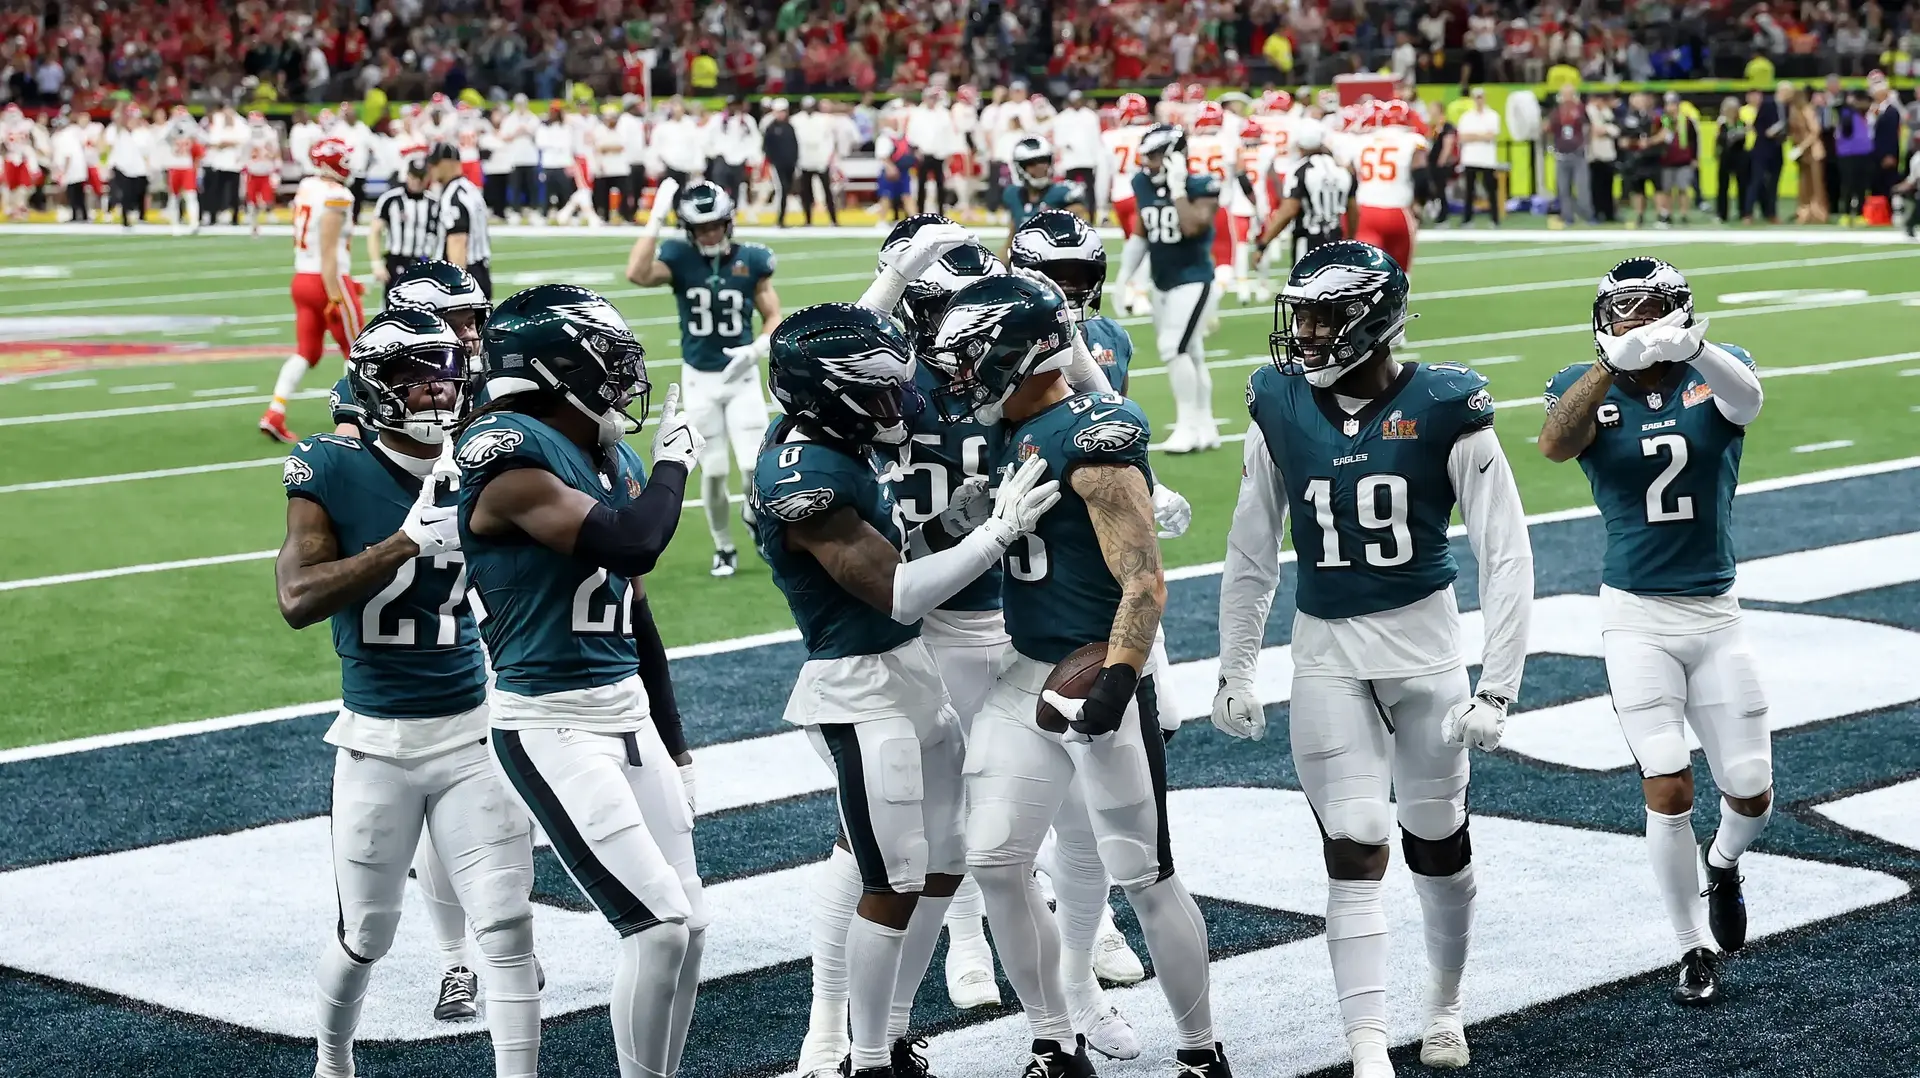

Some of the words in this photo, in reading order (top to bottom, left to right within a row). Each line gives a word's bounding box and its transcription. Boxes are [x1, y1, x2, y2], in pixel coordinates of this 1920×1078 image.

[1360, 147, 1398, 182] 65
[686, 287, 743, 337] 33
[1597, 404, 1619, 424] C
[1642, 419, 1676, 431] EAGLES
[1333, 453, 1369, 466] EAGLES
[1641, 434, 1694, 523] 2
[1304, 475, 1413, 567] 19
[363, 549, 467, 645] 27
